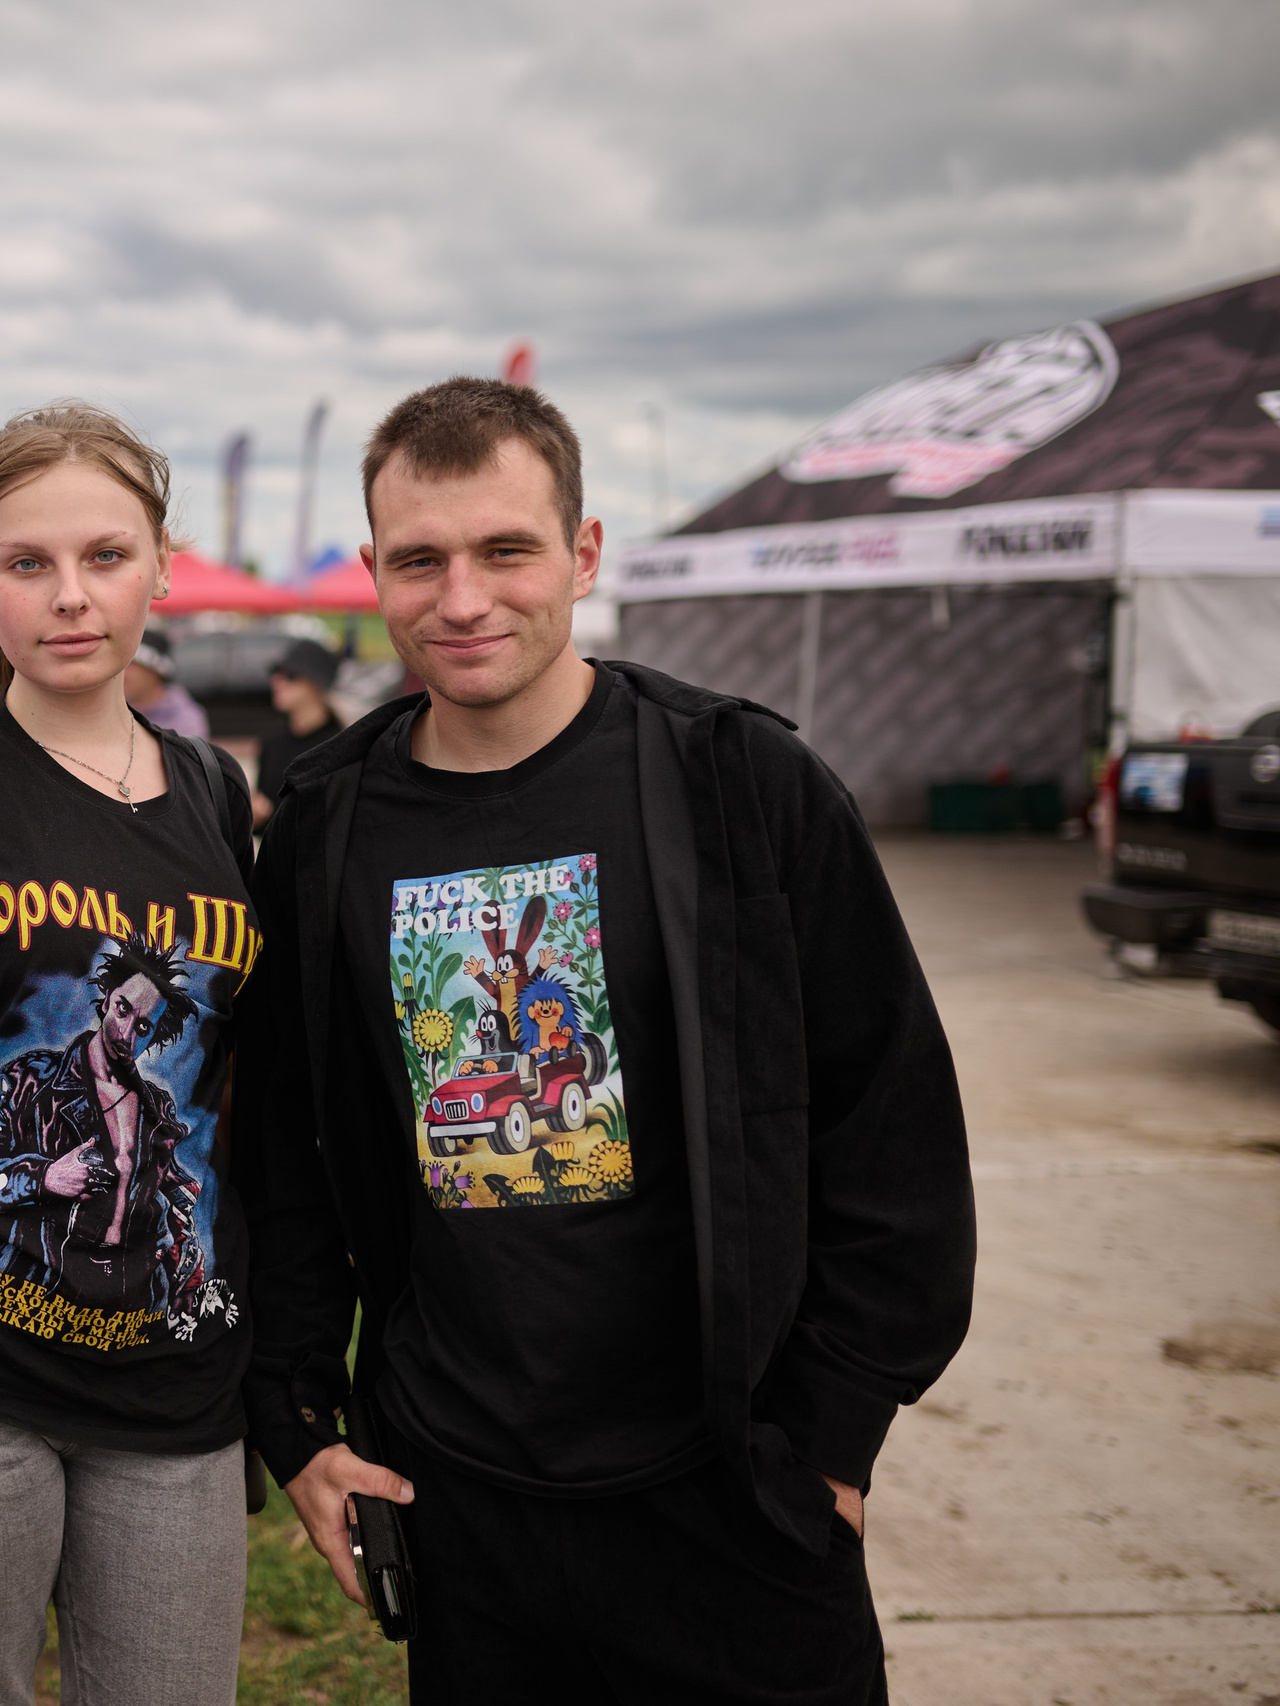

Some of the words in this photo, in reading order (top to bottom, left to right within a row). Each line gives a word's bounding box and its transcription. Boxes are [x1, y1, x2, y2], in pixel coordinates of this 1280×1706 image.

[395, 874, 488, 912] FUCK
[498, 864, 571, 898] THE
[393, 901, 521, 939] POLICE
[147, 901, 176, 952] и
[186, 892, 264, 998] Шу
[21, 1282, 47, 1299] НЕ
[53, 1293, 102, 1319] ВИДЯ
[61, 1332, 110, 1351] СВОИ
